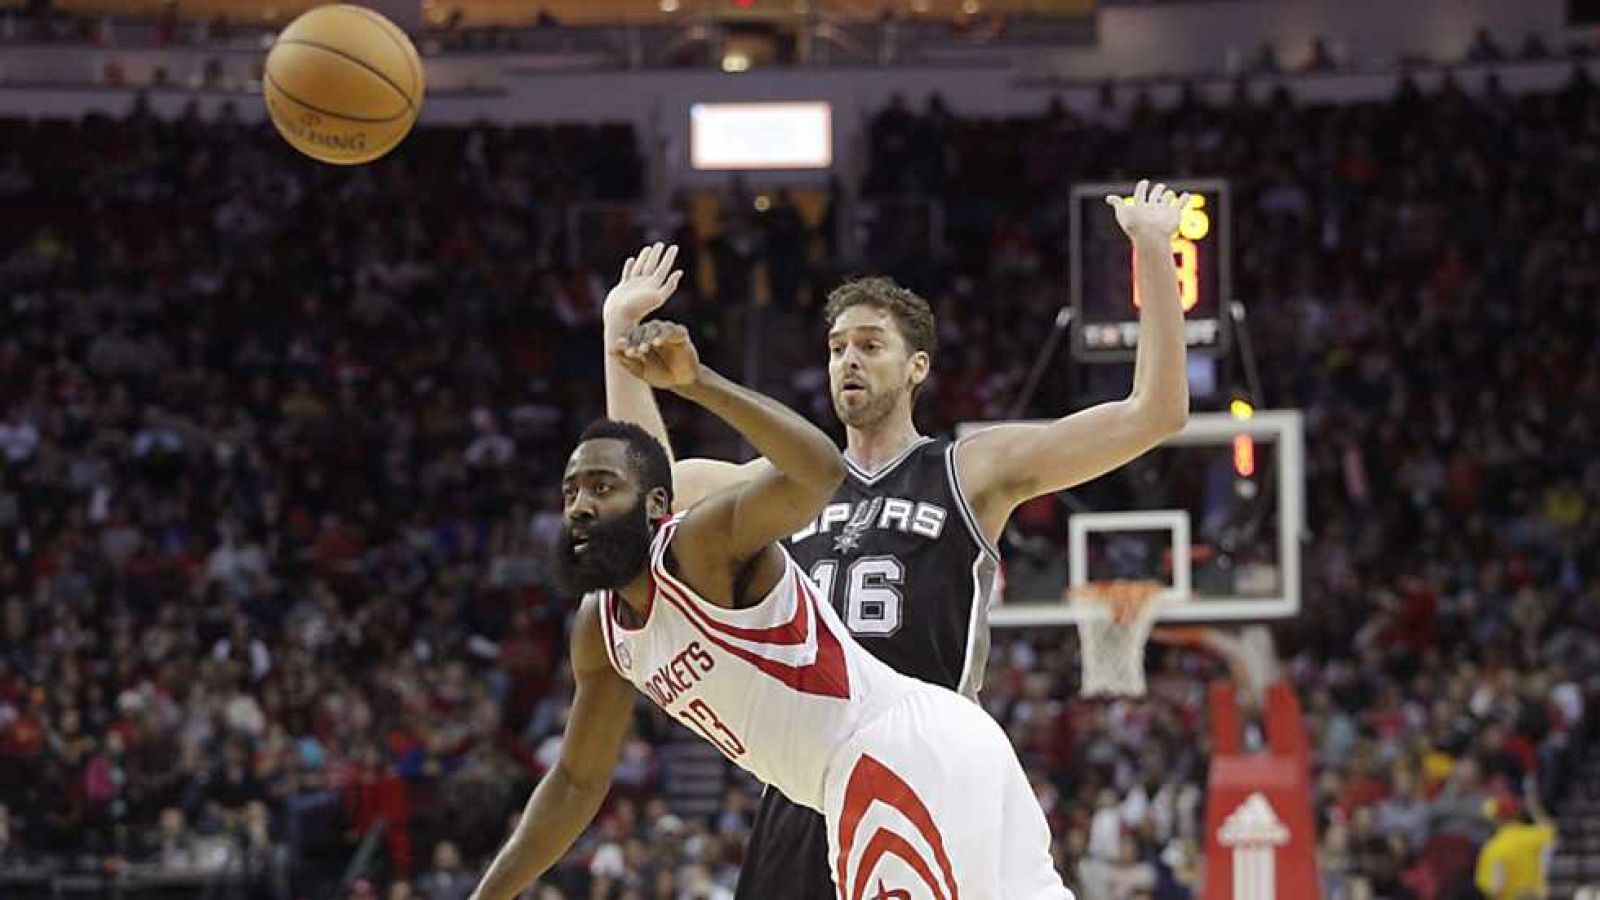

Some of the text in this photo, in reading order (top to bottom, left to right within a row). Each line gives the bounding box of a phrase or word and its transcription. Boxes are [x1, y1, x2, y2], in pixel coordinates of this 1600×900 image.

[809, 554, 905, 638] 16
[645, 641, 715, 707] OCKETS
[679, 698, 746, 759] 13
